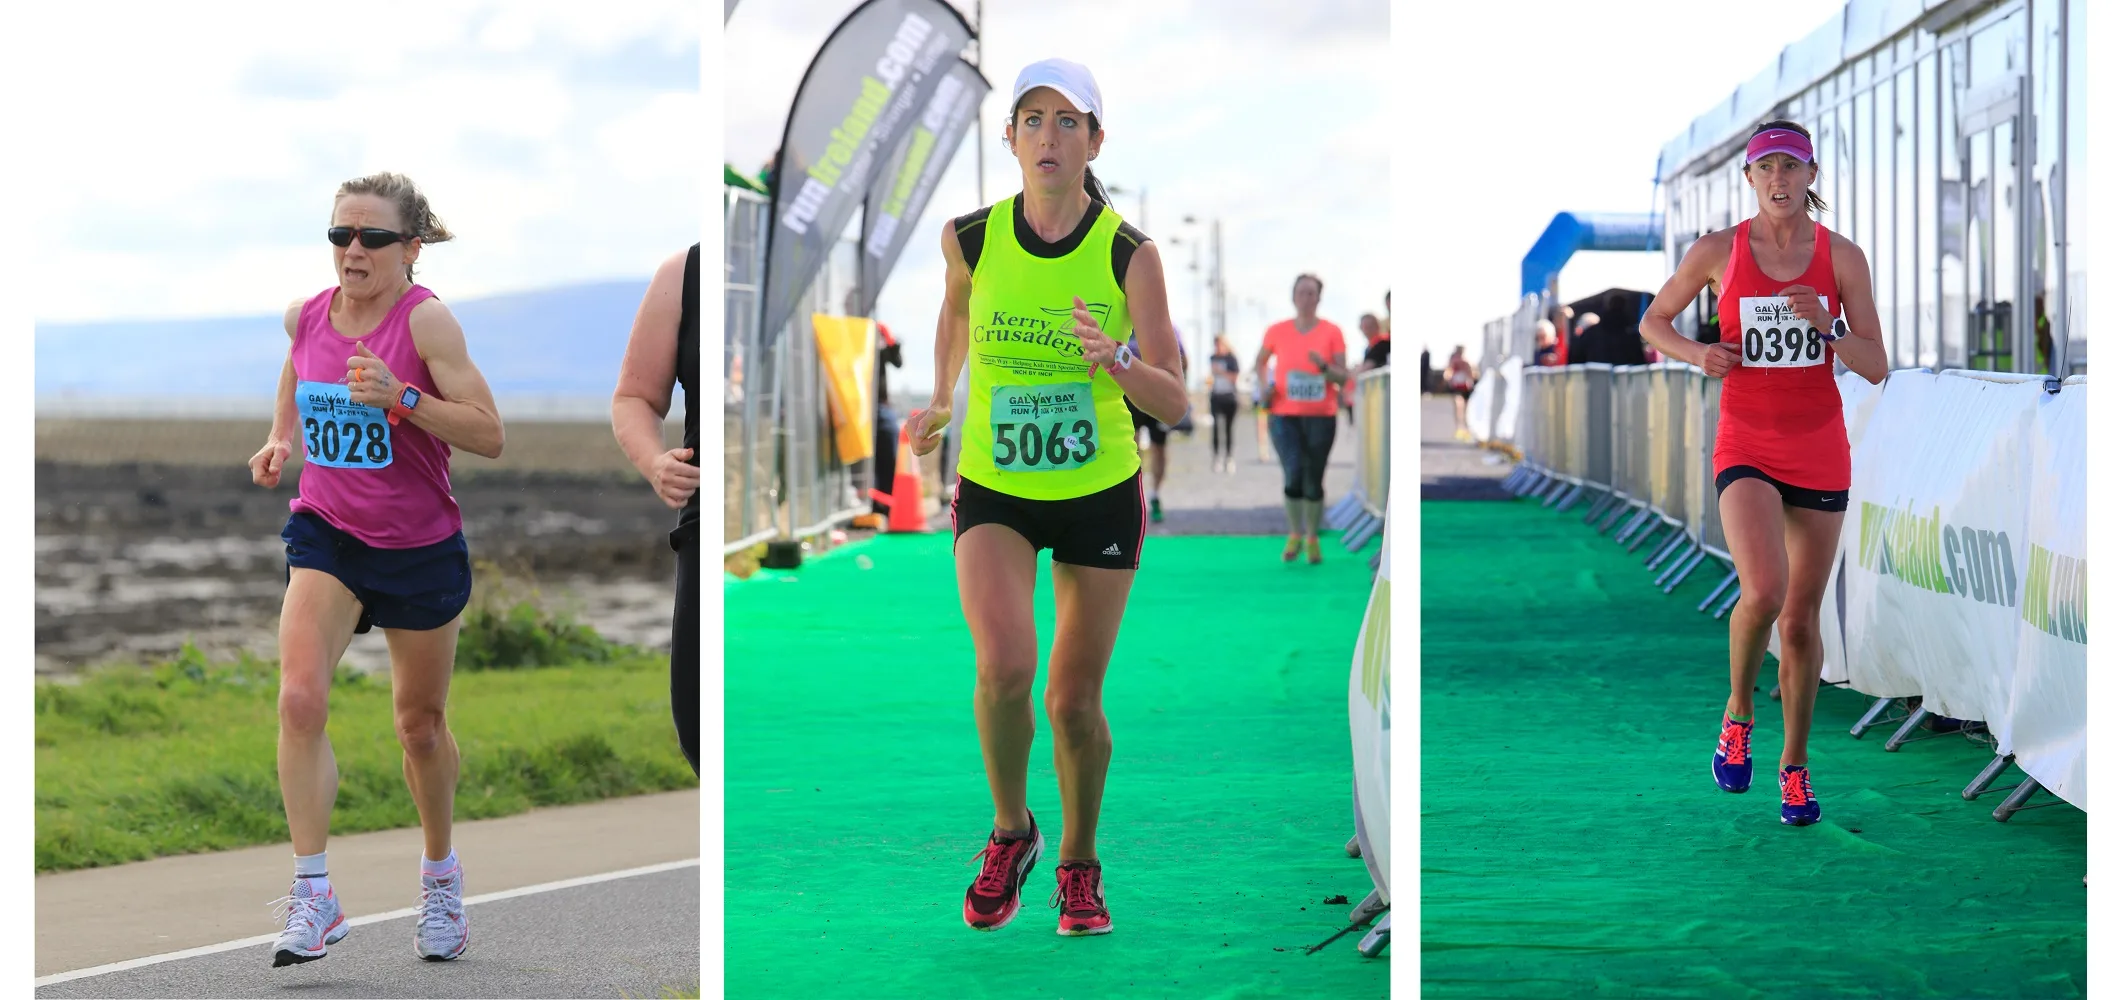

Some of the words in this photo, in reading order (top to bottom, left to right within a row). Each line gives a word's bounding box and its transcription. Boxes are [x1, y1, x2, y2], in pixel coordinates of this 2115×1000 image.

[991, 311, 1052, 334] Kerry
[974, 325, 1086, 357] Crusaders
[1745, 327, 1821, 362] 0398
[1055, 393, 1075, 403] BAY
[305, 418, 389, 464] 3028
[995, 420, 1096, 467] 5063
